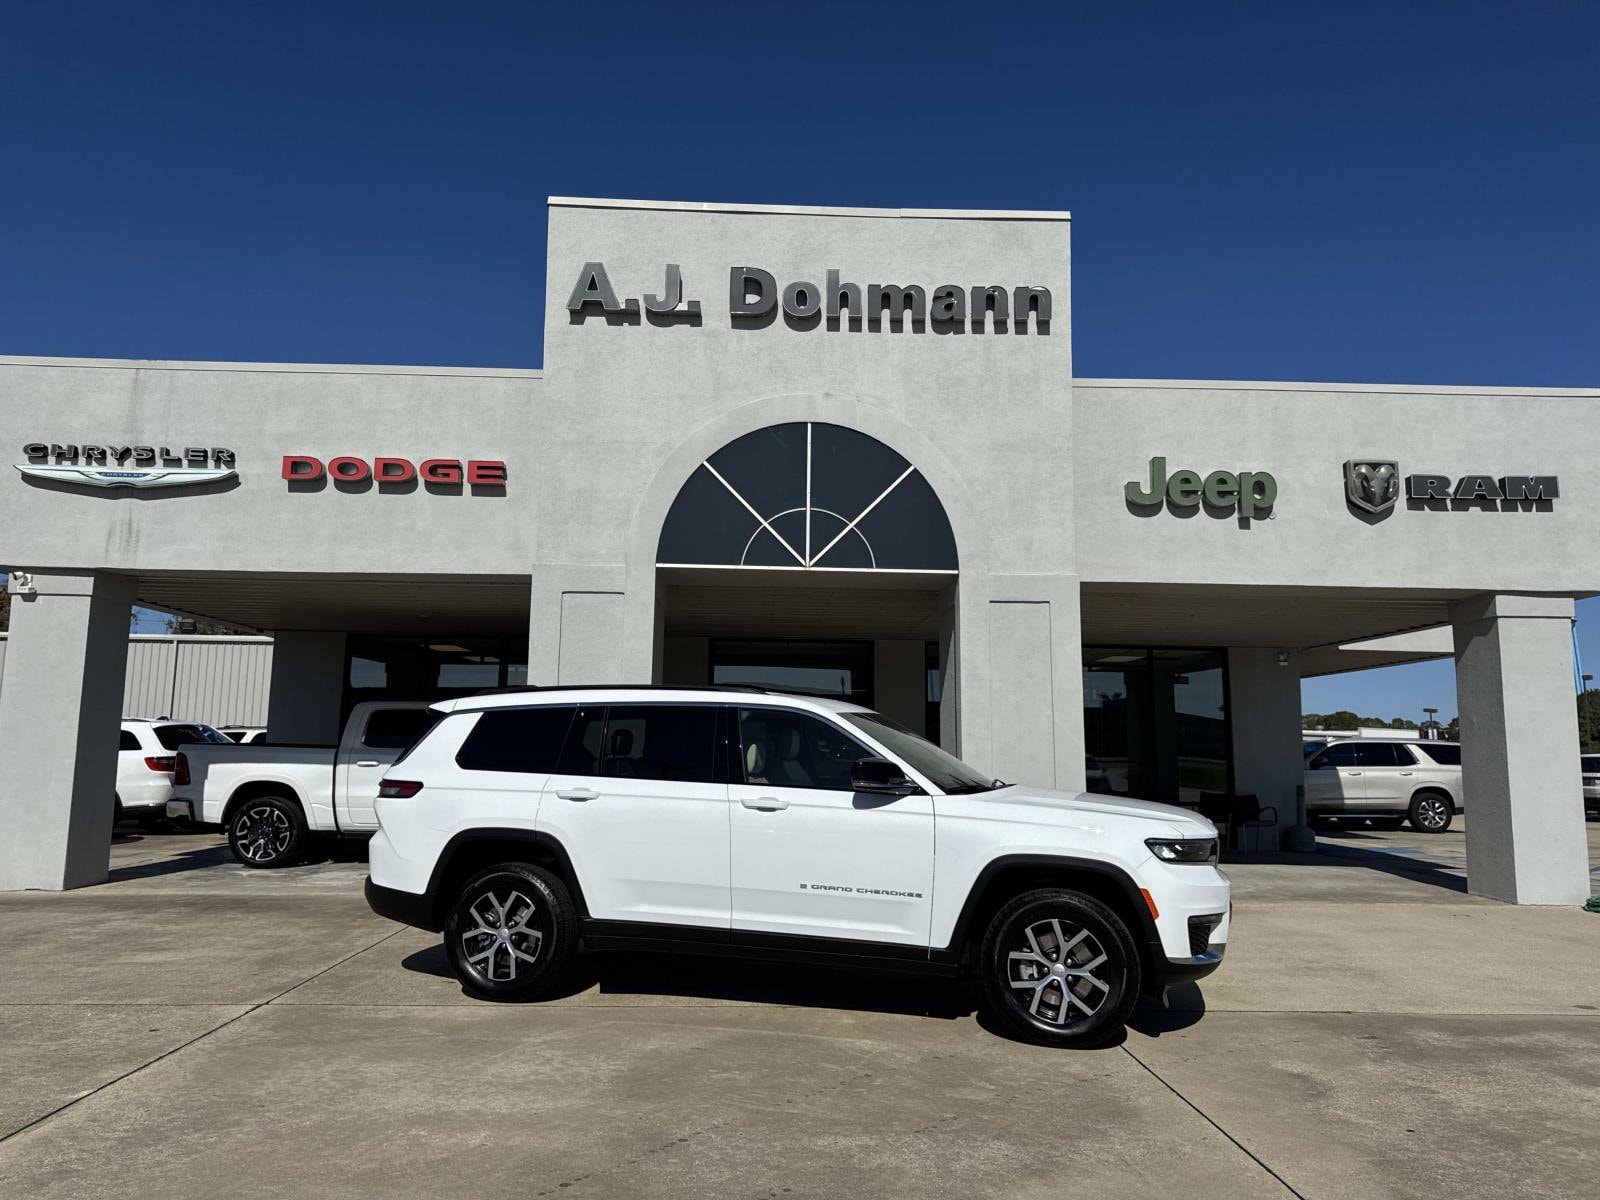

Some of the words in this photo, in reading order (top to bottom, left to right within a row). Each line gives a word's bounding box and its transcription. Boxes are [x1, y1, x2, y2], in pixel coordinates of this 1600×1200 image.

[566, 261, 702, 317] A.J.
[730, 266, 1053, 326] Dohmann
[22, 442, 235, 463] CHRYSLER
[281, 455, 507, 489] DODGE
[1125, 456, 1278, 520] Jeep
[1405, 473, 1560, 504] RAM
[810, 883, 853, 892] GRAND
[856, 888, 923, 898] CHEROKEE
